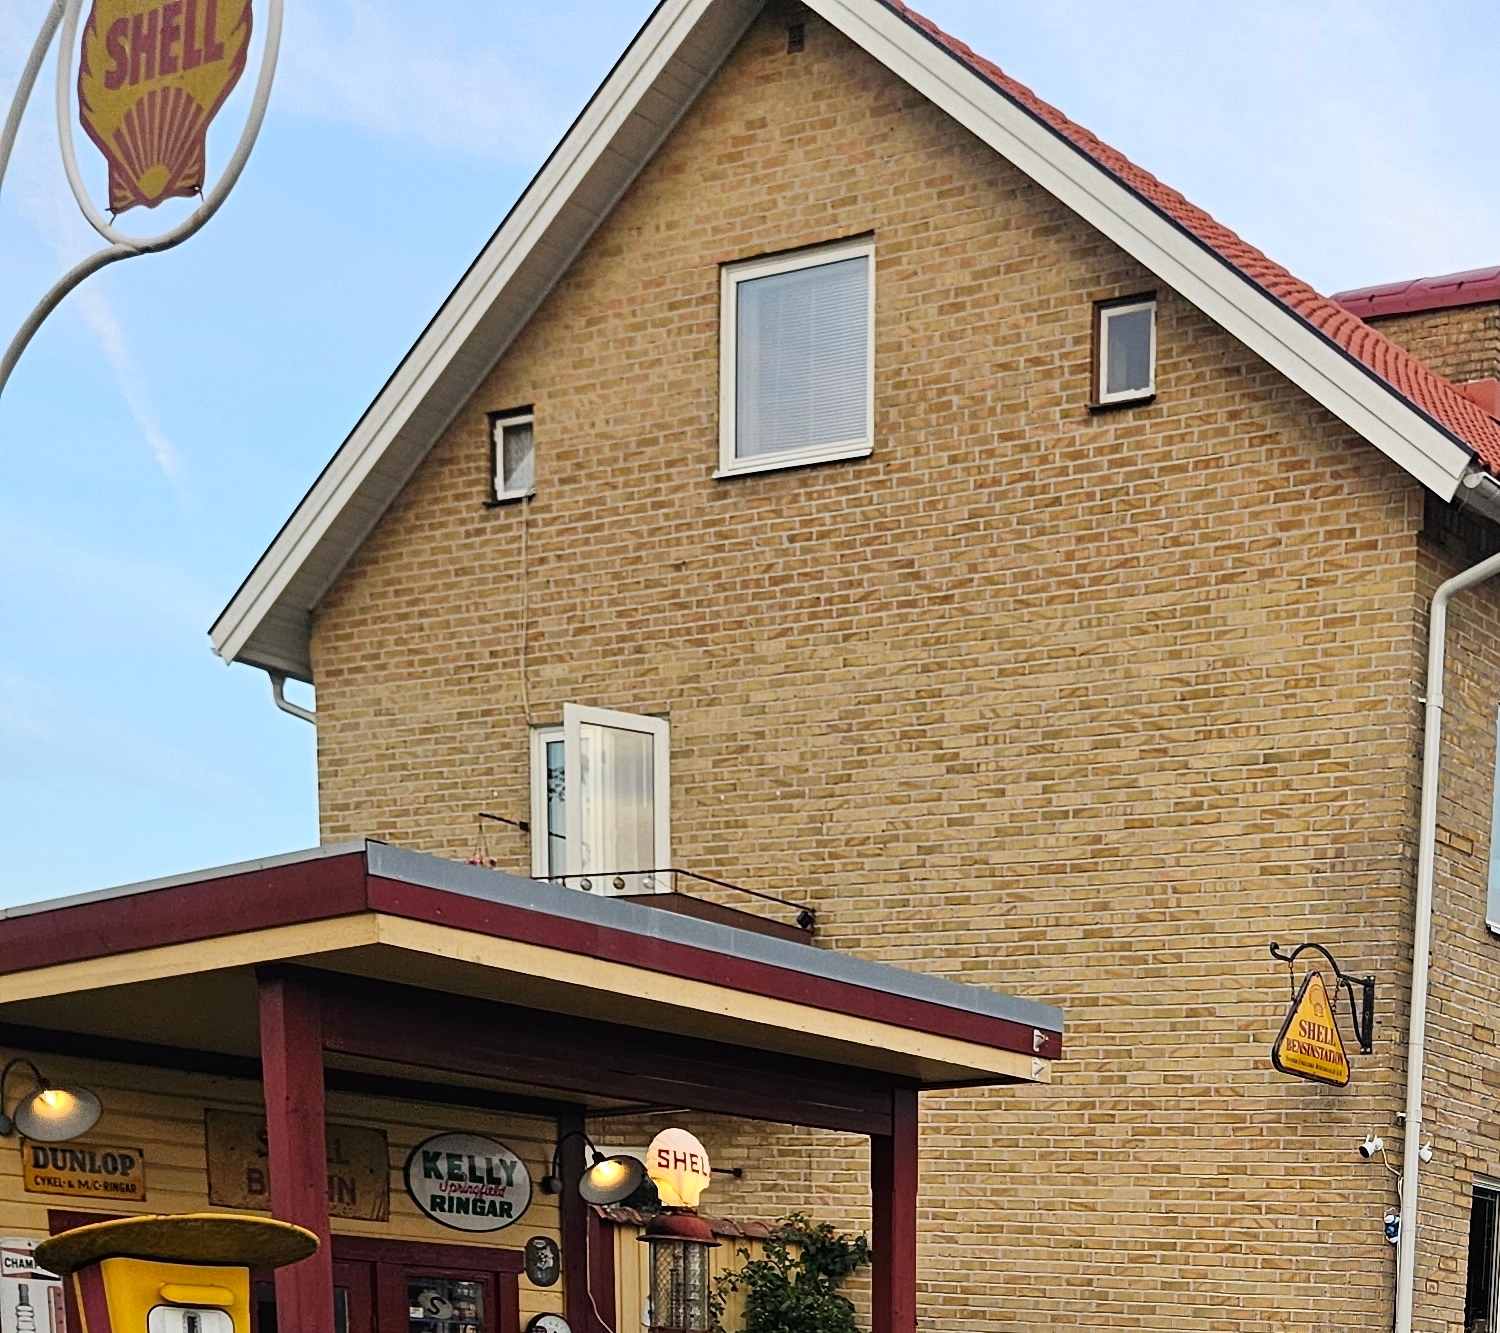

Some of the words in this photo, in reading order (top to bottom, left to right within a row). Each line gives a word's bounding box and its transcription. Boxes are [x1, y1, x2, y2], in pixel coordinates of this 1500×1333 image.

[104, 0, 224, 91] SHELL
[1299, 1019, 1336, 1047] SHELL
[1286, 1037, 1344, 1067] BENSINSTATION
[31, 1145, 136, 1177] DUNLOP
[421, 1149, 518, 1188] KELLY
[657, 1148, 708, 1177] SHEL
[247, 1167, 357, 1205] BIN
[429, 1193, 514, 1220] RINGAR
[4, 1256, 34, 1270] CHAM
